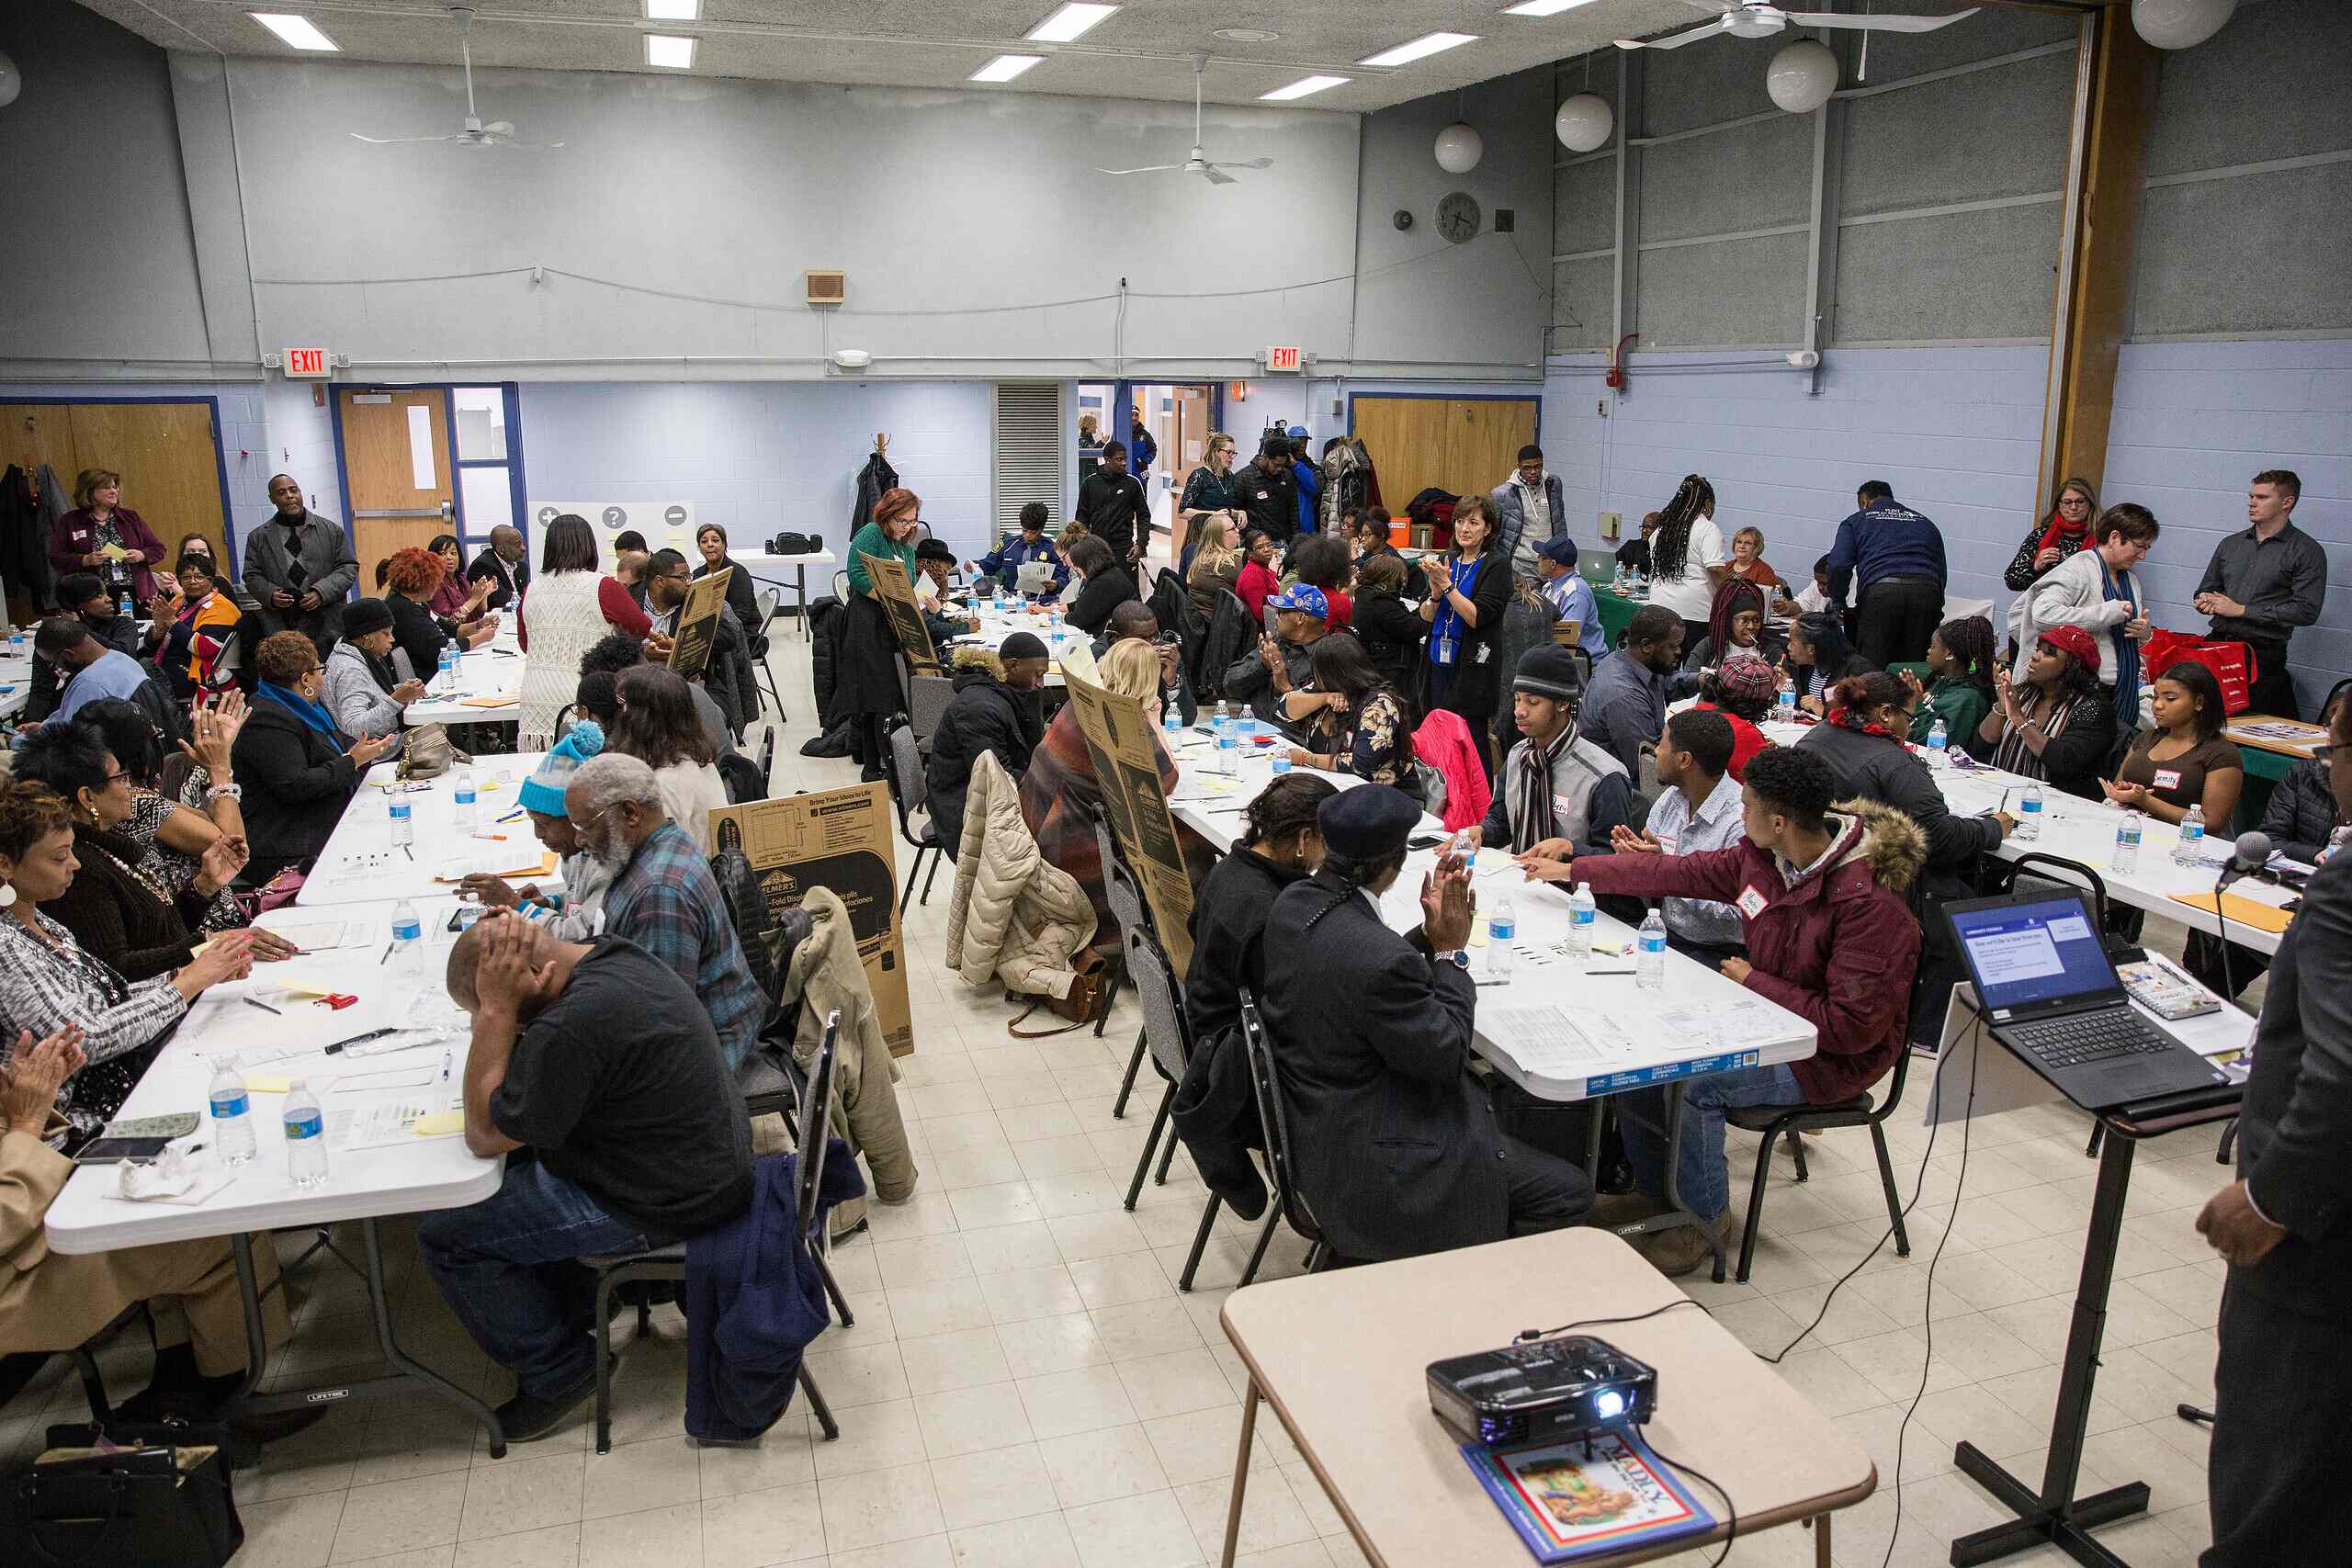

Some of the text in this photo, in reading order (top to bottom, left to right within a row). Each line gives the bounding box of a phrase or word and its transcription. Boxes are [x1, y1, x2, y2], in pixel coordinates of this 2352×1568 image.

[290, 350, 323, 372] EXIT
[1272, 348, 1298, 368] EXIT
[809, 798, 824, 807] Bring
[763, 882, 795, 894] ELMER'S
[786, 894, 806, 904] Displ
